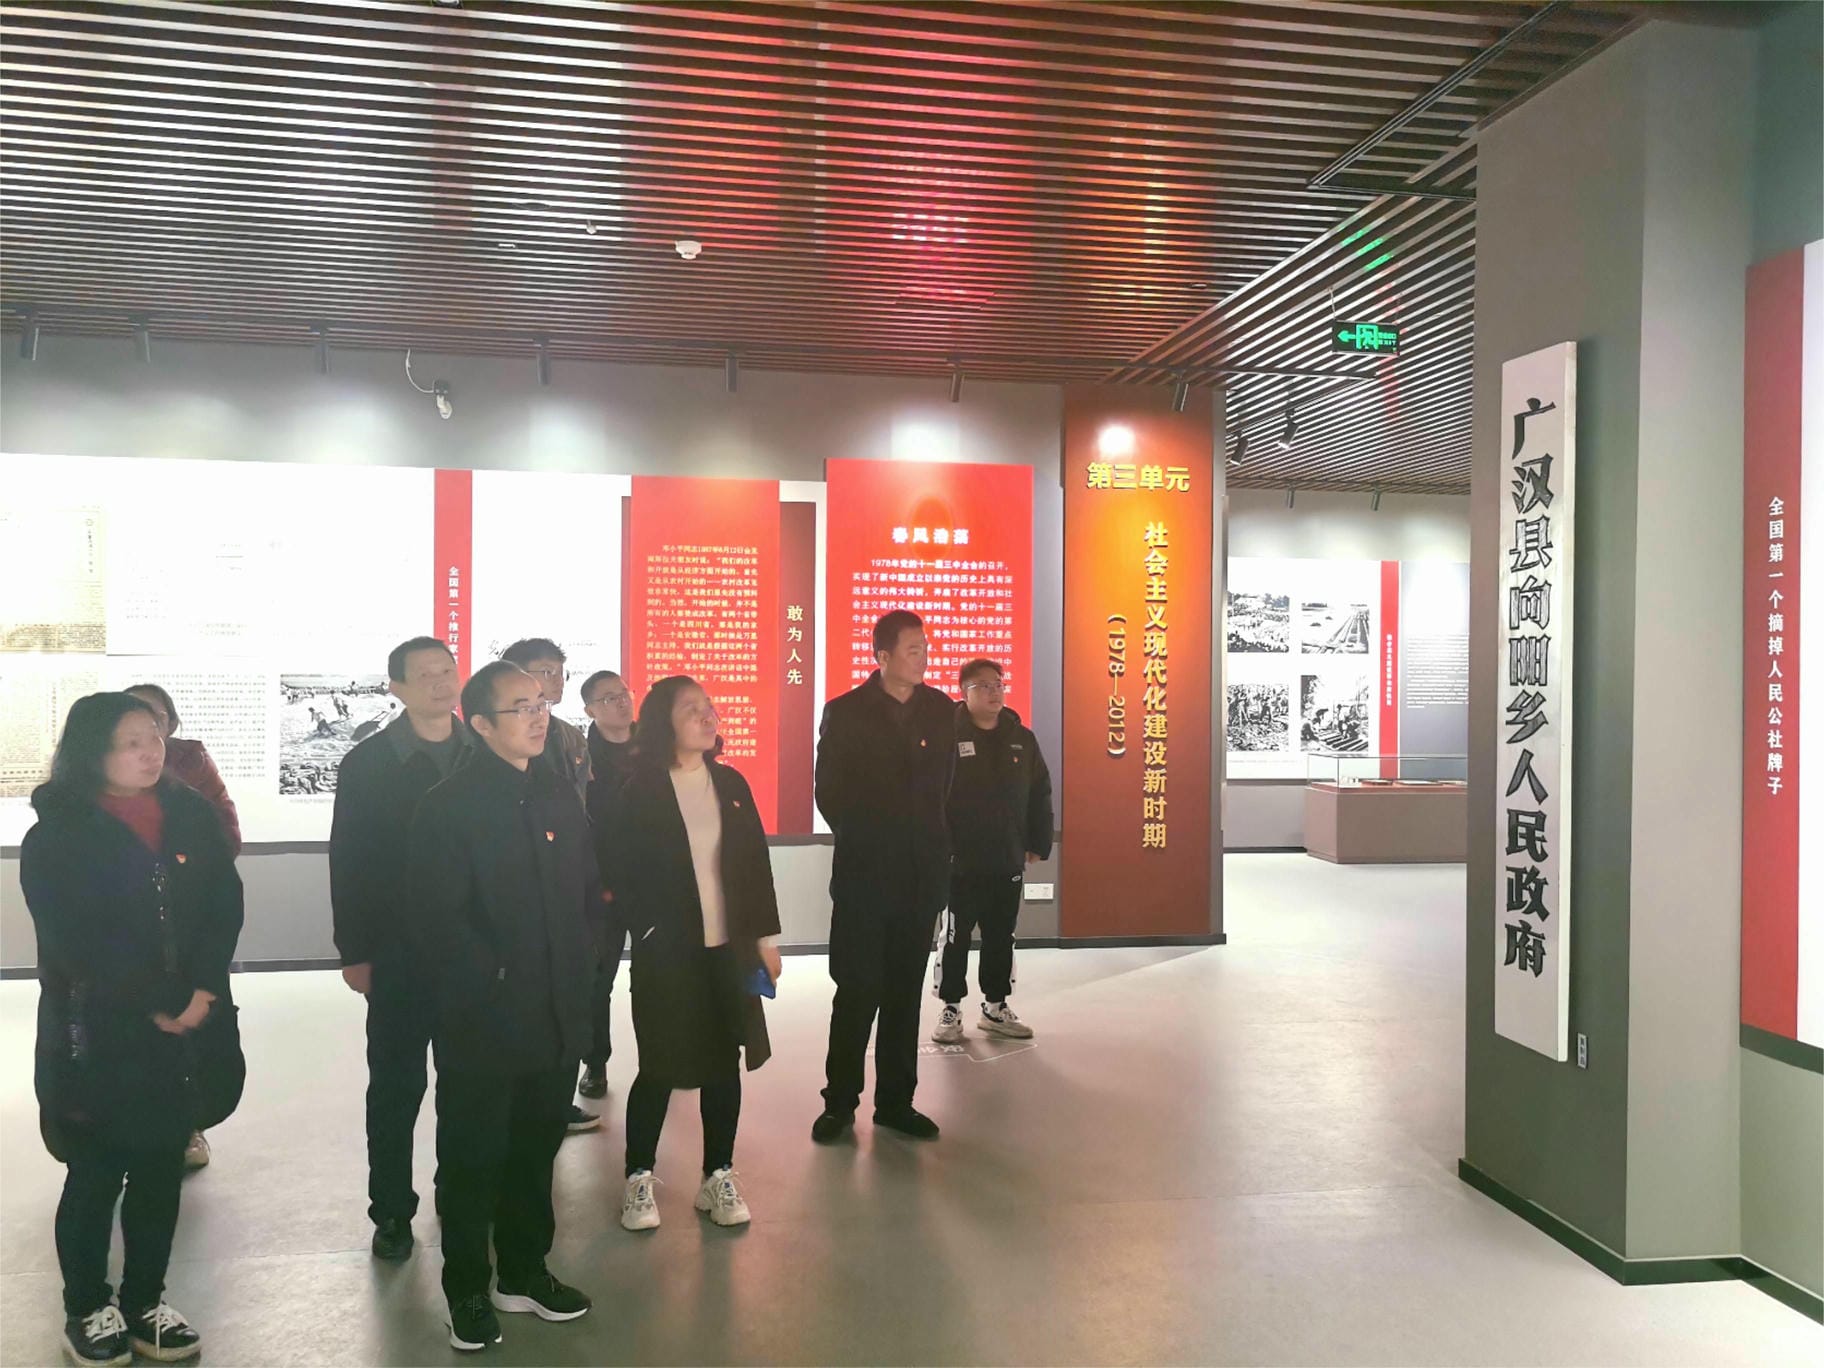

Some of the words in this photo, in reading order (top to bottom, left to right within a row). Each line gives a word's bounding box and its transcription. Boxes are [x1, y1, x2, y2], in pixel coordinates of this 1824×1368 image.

[1086, 462, 1190, 493] 第三单元
[786, 605, 803, 686] 敢为人先
[1142, 521, 1169, 851] 社会主义现代化建设新时期
[1504, 397, 1557, 978] 广汉县向阳乡人民政府
[1767, 496, 1784, 796] 全国第一个摘掉人民公社牌子
